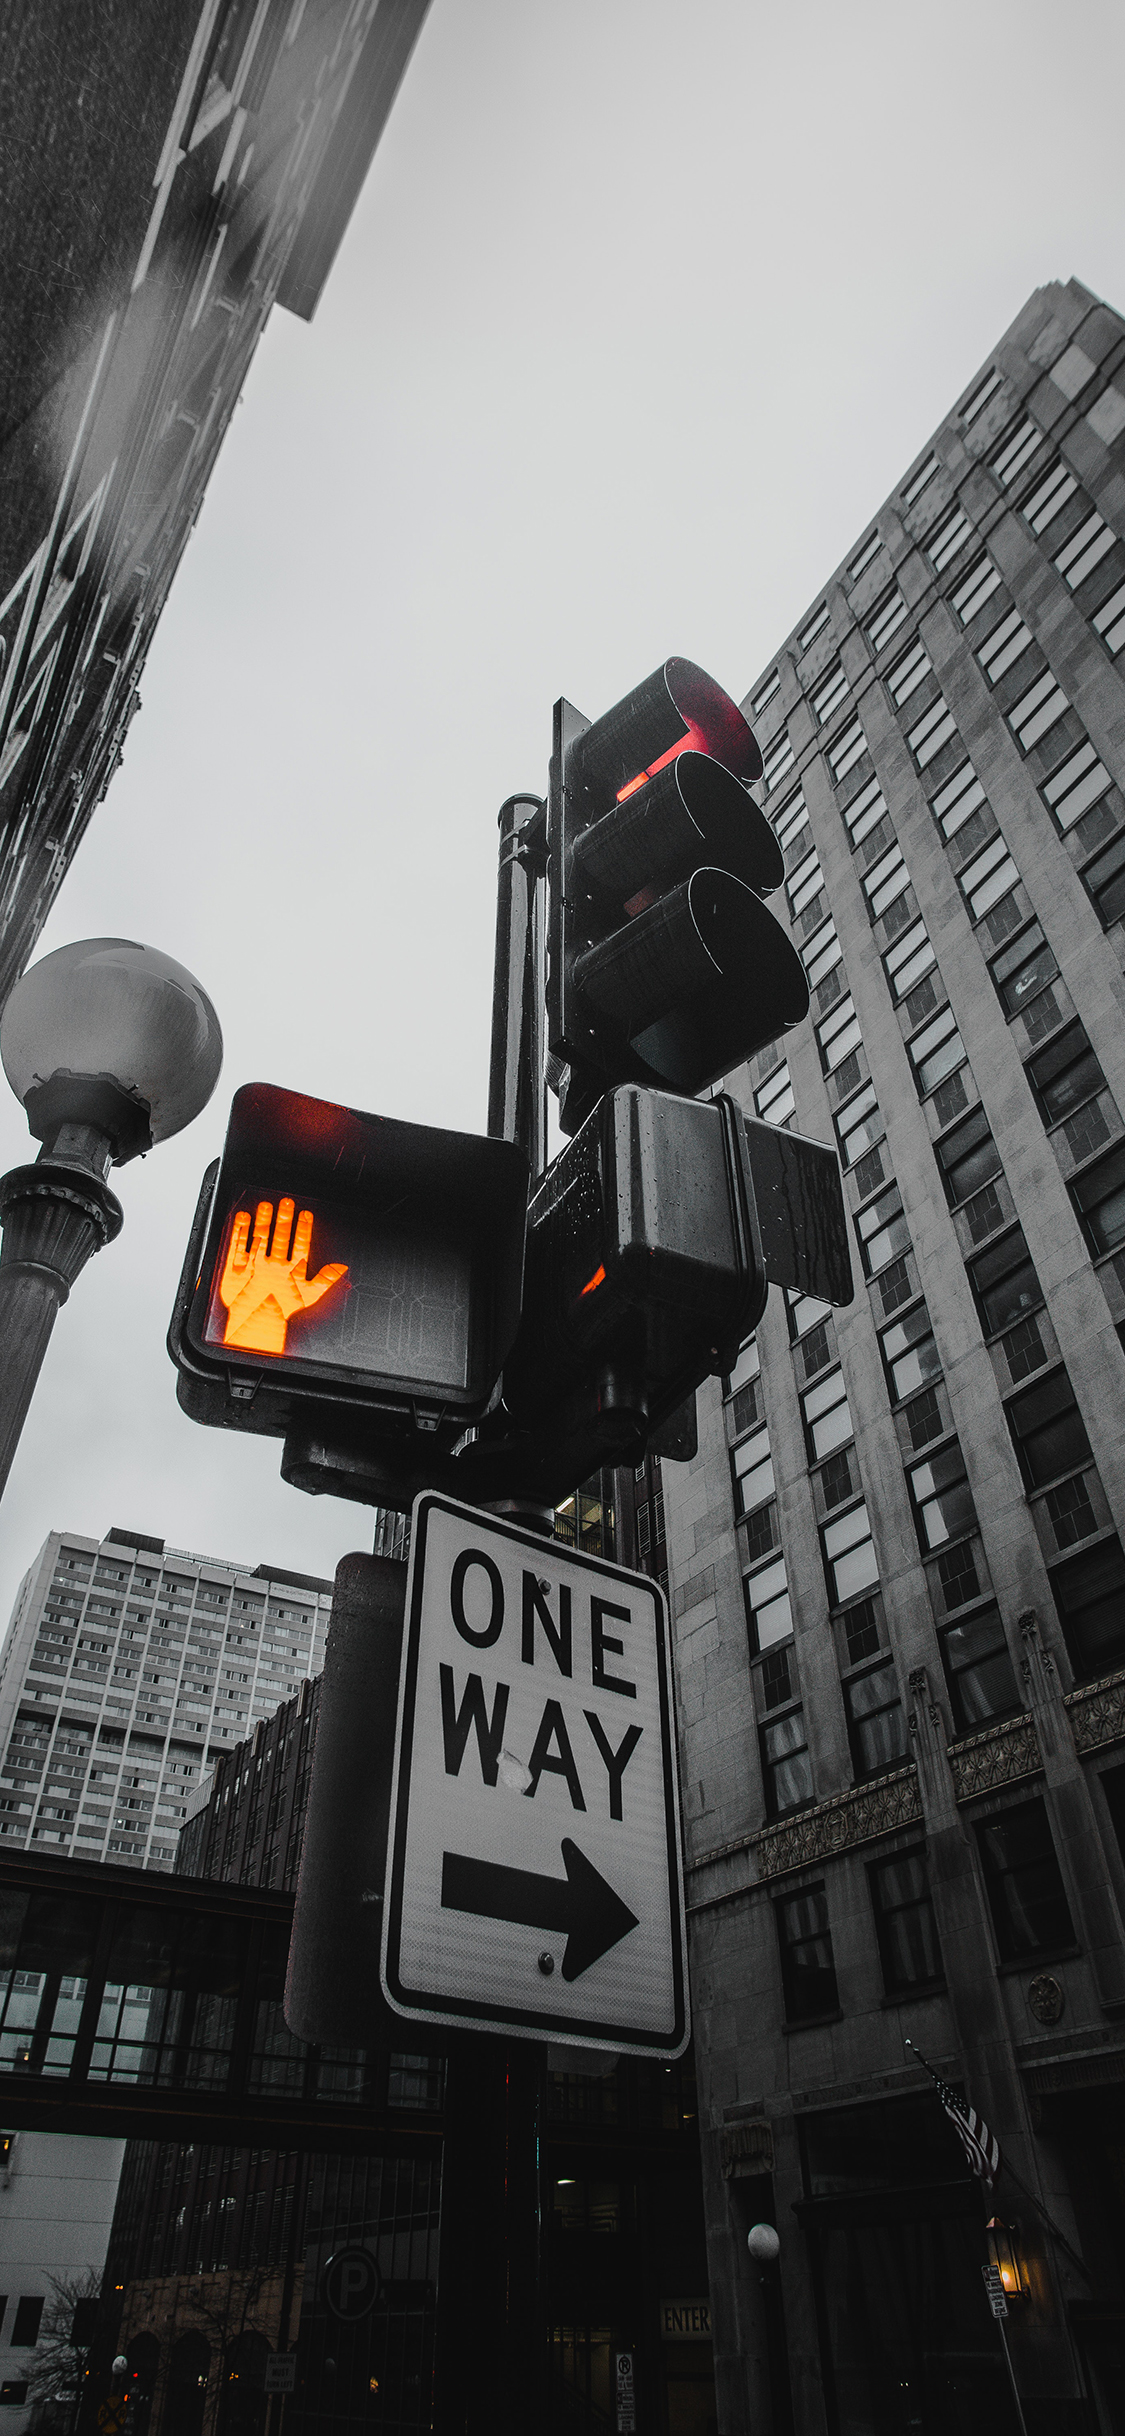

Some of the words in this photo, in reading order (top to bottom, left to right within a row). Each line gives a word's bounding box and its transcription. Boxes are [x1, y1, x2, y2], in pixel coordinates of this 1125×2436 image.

[450, 1548, 637, 1699] ONE
[439, 1662, 643, 1822] WAY
[340, 2261, 369, 2310] P
[664, 2306, 711, 2332] ENTER
[272, 2368, 289, 2376] MUST
